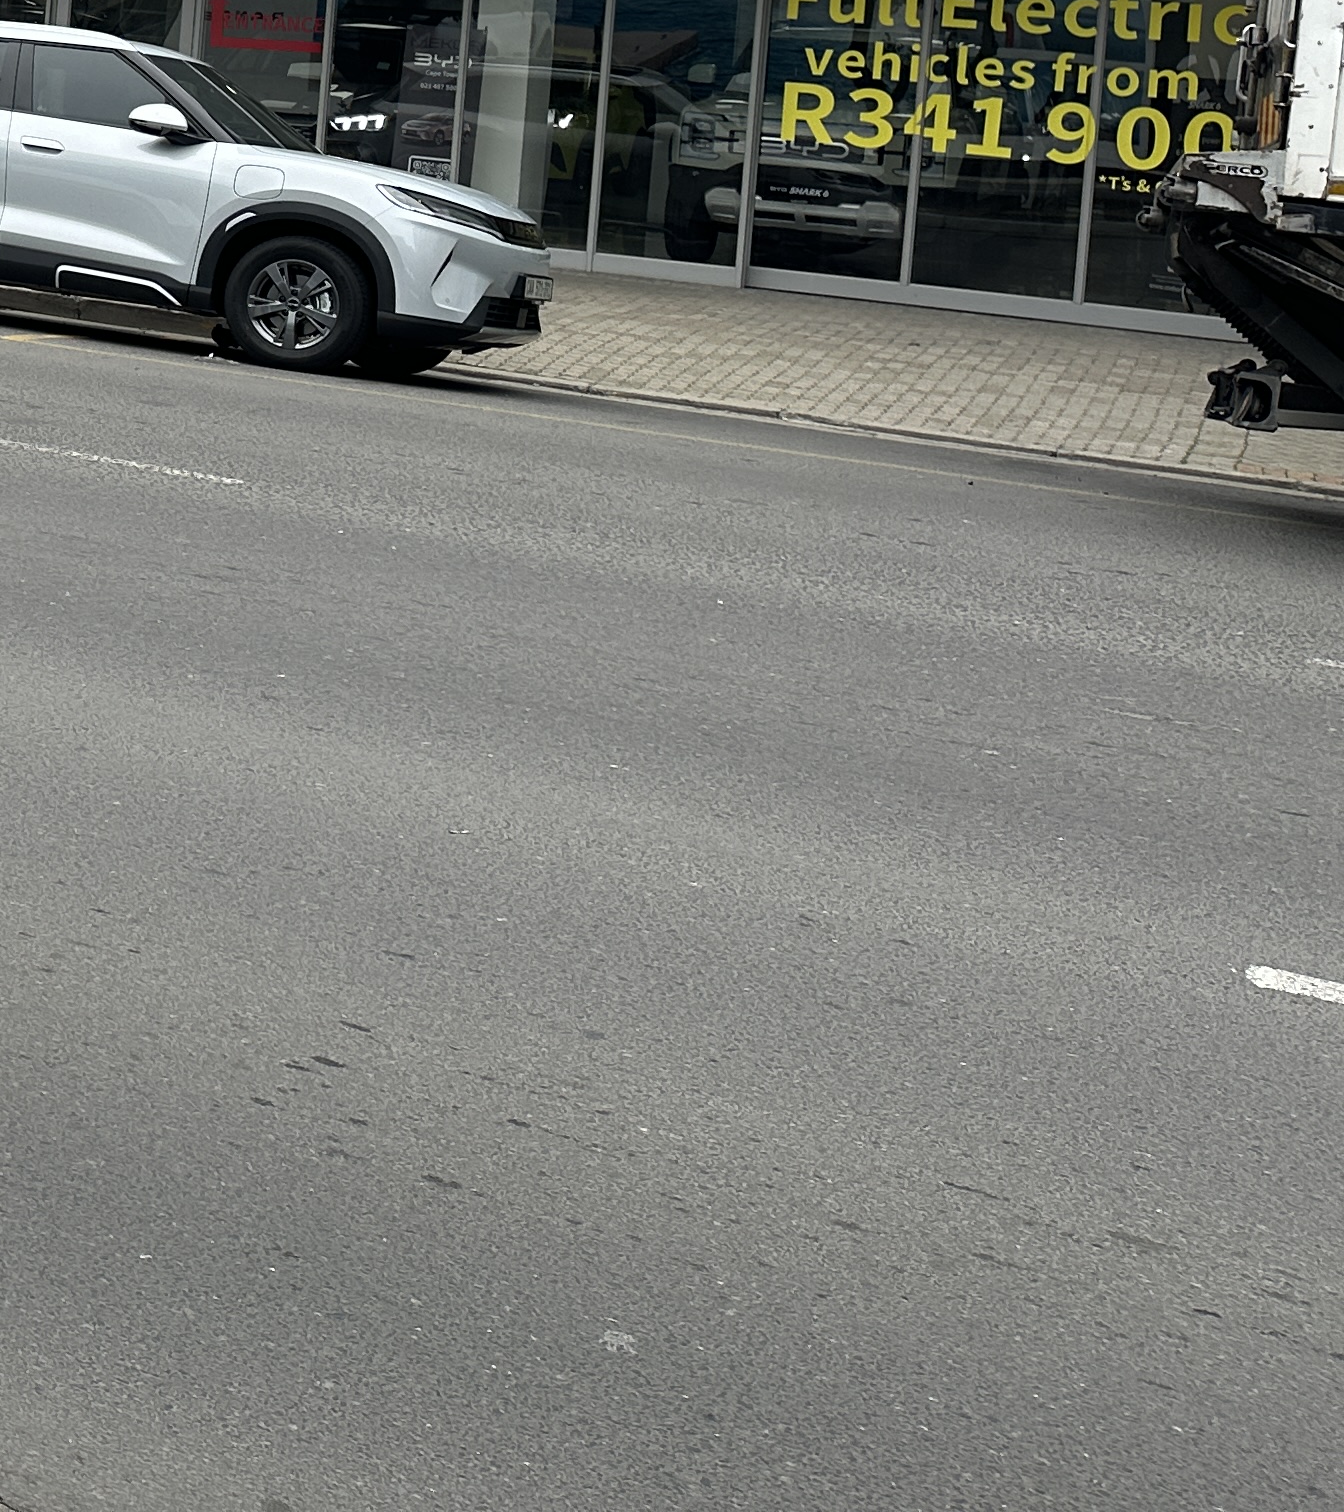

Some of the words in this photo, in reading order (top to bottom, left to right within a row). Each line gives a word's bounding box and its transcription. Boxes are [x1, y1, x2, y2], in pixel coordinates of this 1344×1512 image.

[806, 42, 1035, 90] vehicles
[1052, 52, 1199, 101] from
[1135, 178, 1151, 194] &
